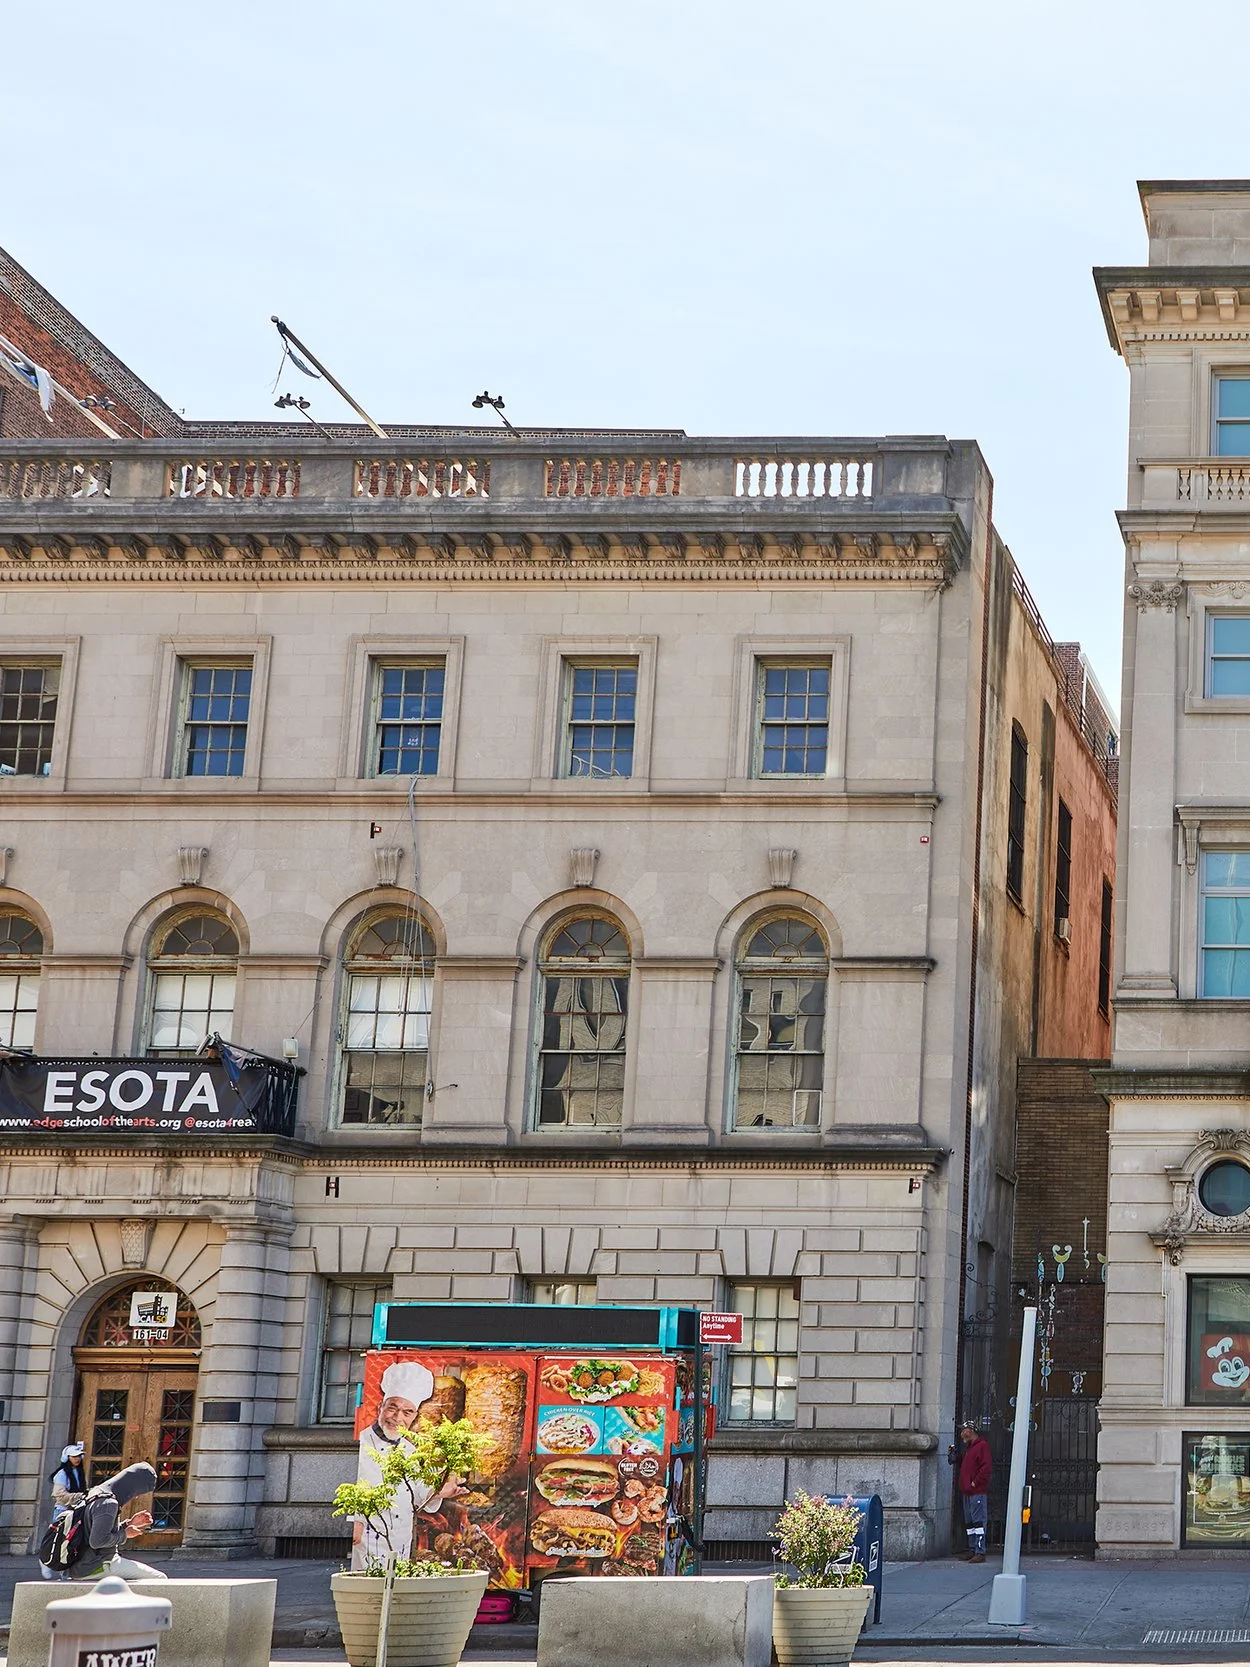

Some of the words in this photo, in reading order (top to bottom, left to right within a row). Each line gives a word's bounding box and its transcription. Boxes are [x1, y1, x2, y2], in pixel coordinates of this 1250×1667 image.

[43, 1070, 219, 1113] ESOTA
[0, 1114, 181, 1130] www.edgeschoolofthearts.org
[135, 1330, 168, 1339] 161-04
